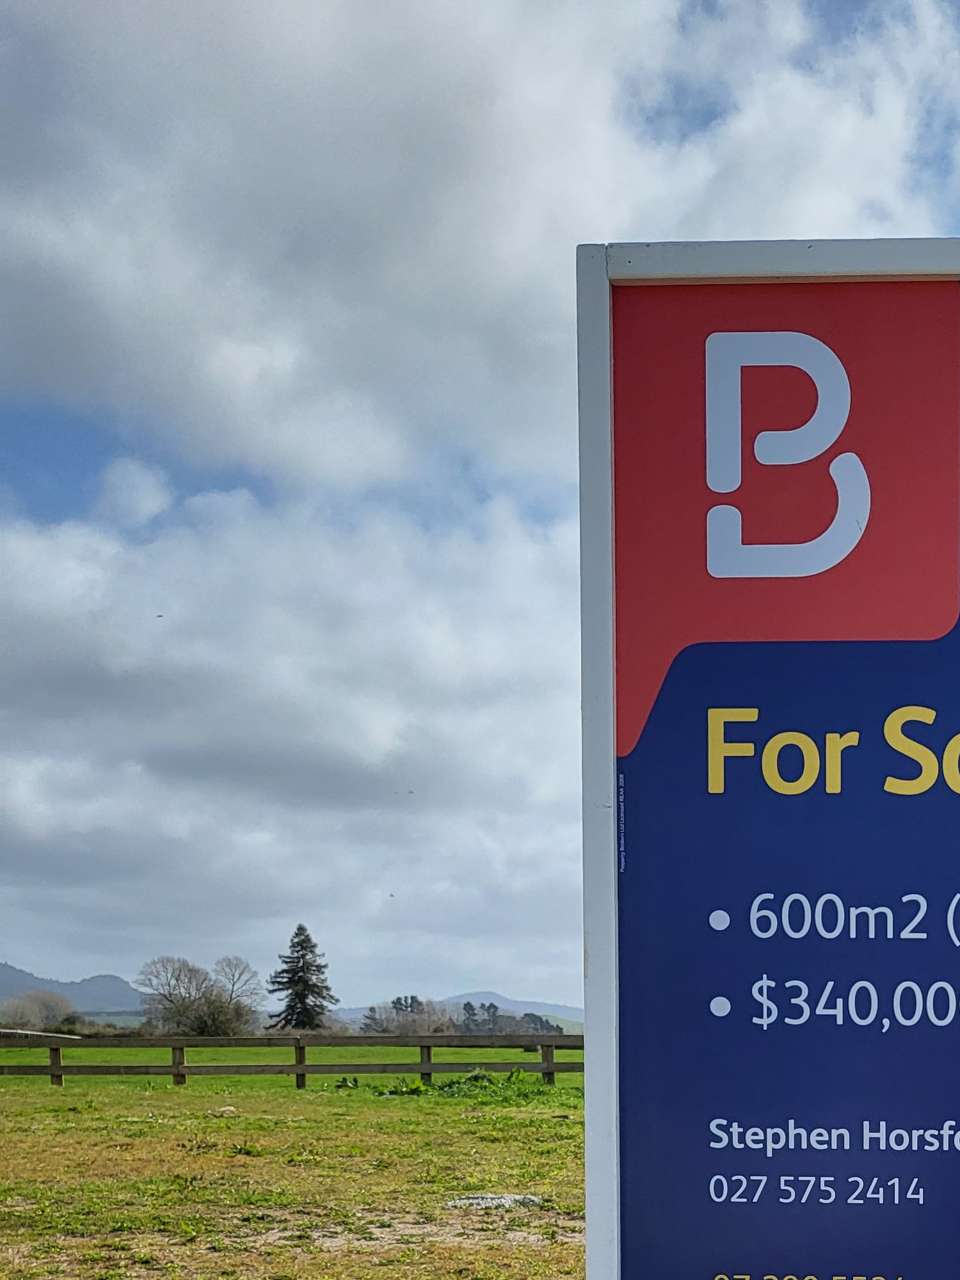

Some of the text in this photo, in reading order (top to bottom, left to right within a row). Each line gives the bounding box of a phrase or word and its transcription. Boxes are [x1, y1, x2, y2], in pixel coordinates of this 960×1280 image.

[705, 331, 871, 579] B
[708, 707, 860, 795] For
[749, 892, 928, 940] 600m2
[709, 1118, 850, 1158] Stephen
[709, 1174, 925, 1205] 027 575 2414
